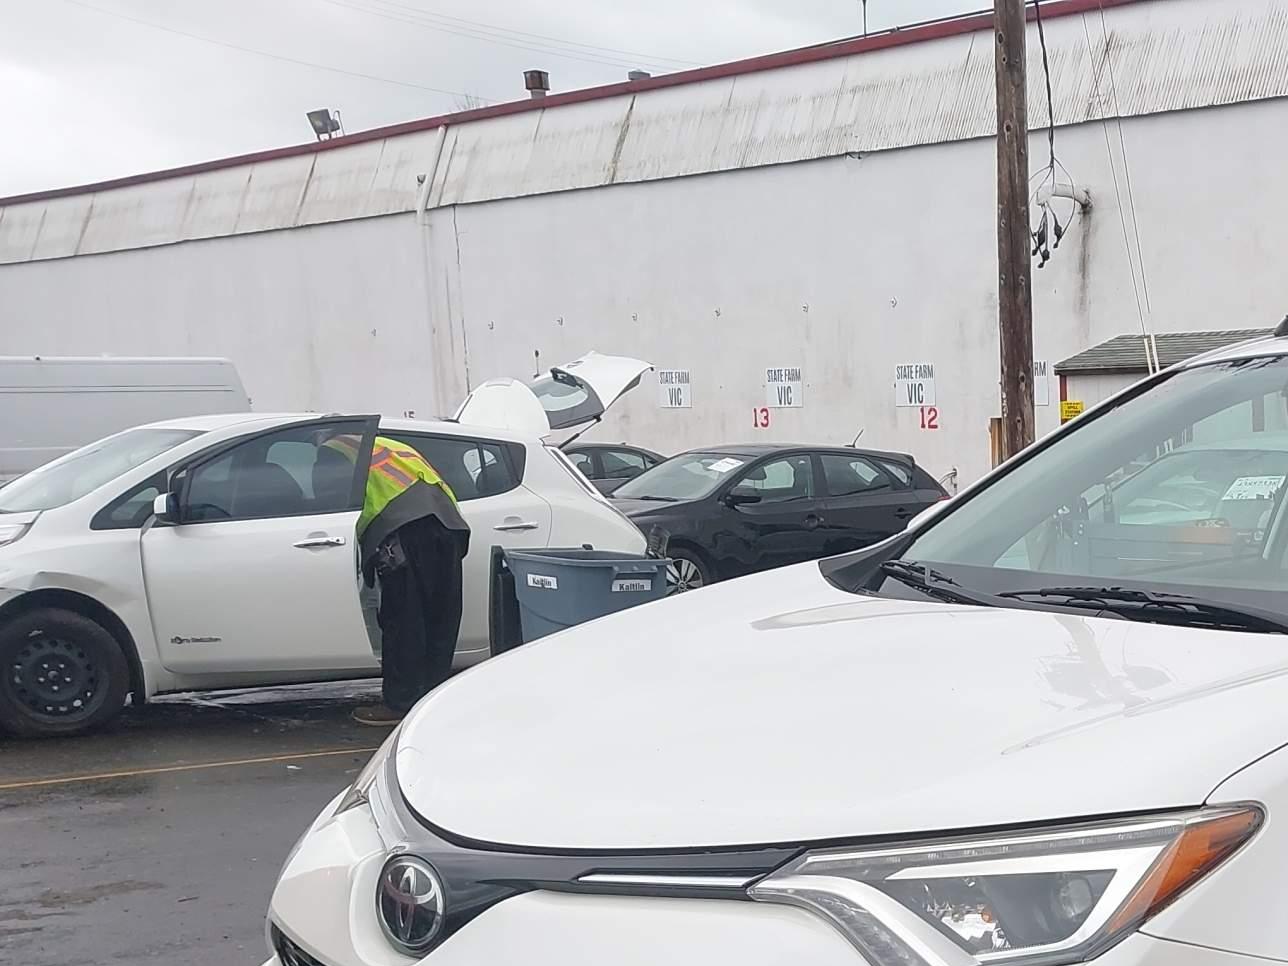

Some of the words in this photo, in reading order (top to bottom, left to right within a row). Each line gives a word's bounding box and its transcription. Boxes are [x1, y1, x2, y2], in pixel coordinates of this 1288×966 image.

[660, 371, 674, 385] STATE
[675, 371, 690, 384] FARM
[767, 369, 784, 383] STATE
[785, 368, 801, 382] FARM
[896, 365, 914, 380] STATE
[915, 364, 934, 379] FARM
[1034, 362, 1047, 377] RM
[668, 387, 683, 406] VIC
[777, 385, 793, 406] VIC
[907, 382, 924, 404] VIC
[753, 408, 769, 428] 13
[920, 407, 938, 429] 12
